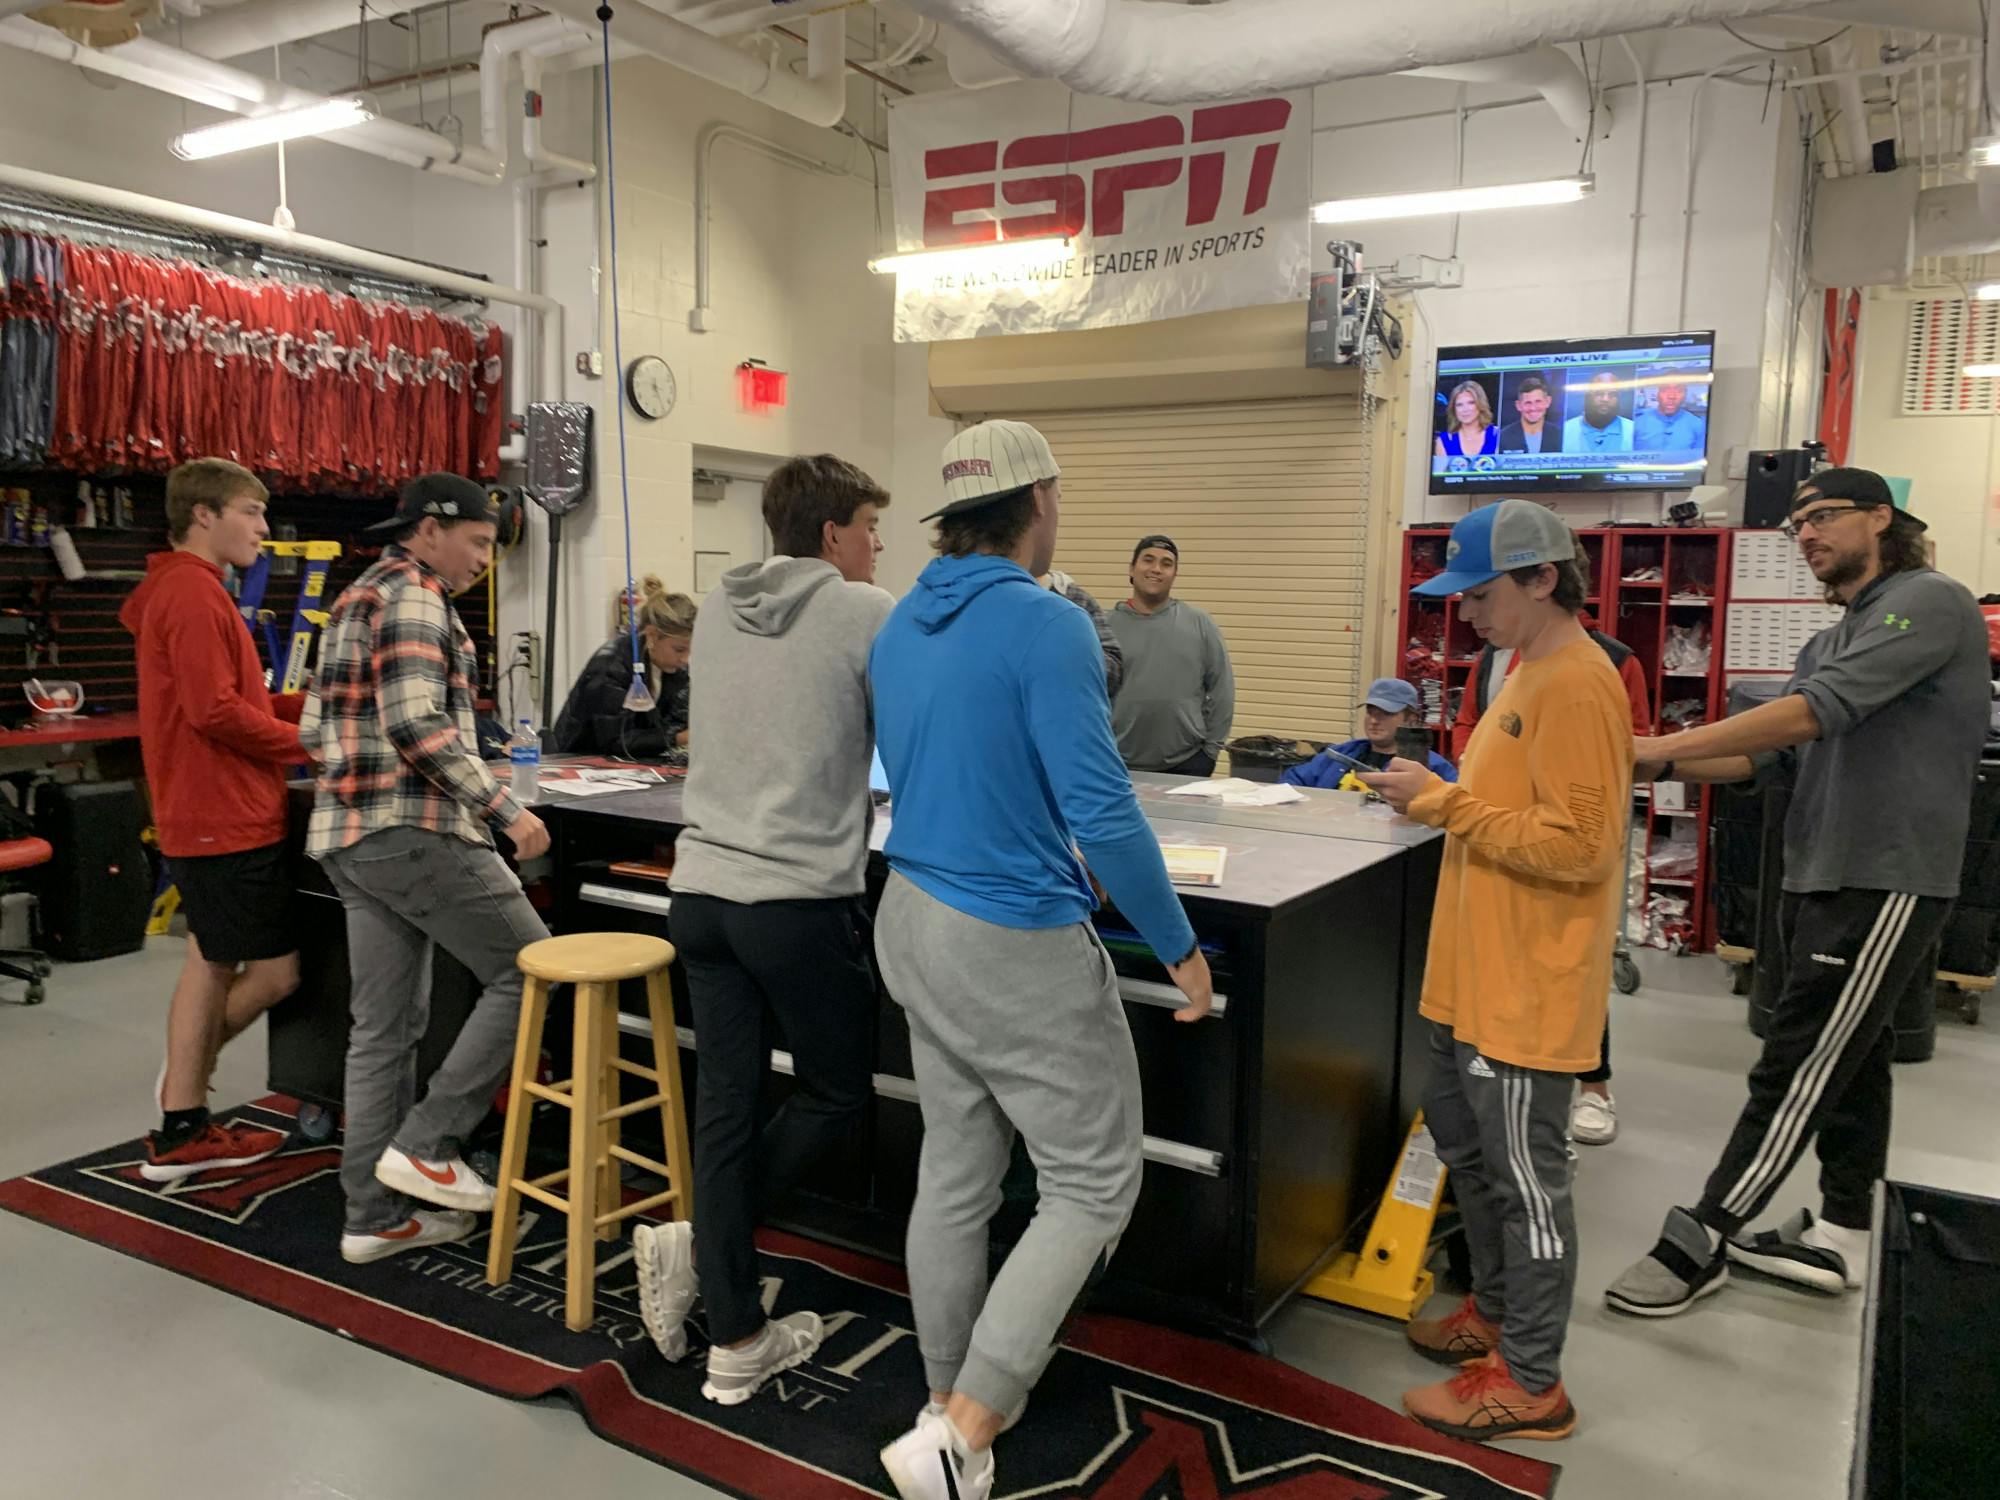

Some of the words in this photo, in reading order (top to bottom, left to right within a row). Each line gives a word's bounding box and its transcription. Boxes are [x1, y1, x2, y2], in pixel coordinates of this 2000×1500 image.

[923, 97, 1292, 249] ESPN
[962, 257, 1076, 289] WRWIDE
[1082, 248, 1158, 277] LEADER
[1164, 242, 1184, 267] IN
[1188, 226, 1266, 263] SPORTS
[1553, 355, 1577, 364] NFL
[1580, 353, 1609, 362] LIVE
[405, 1254, 570, 1322] ATHLETIC
